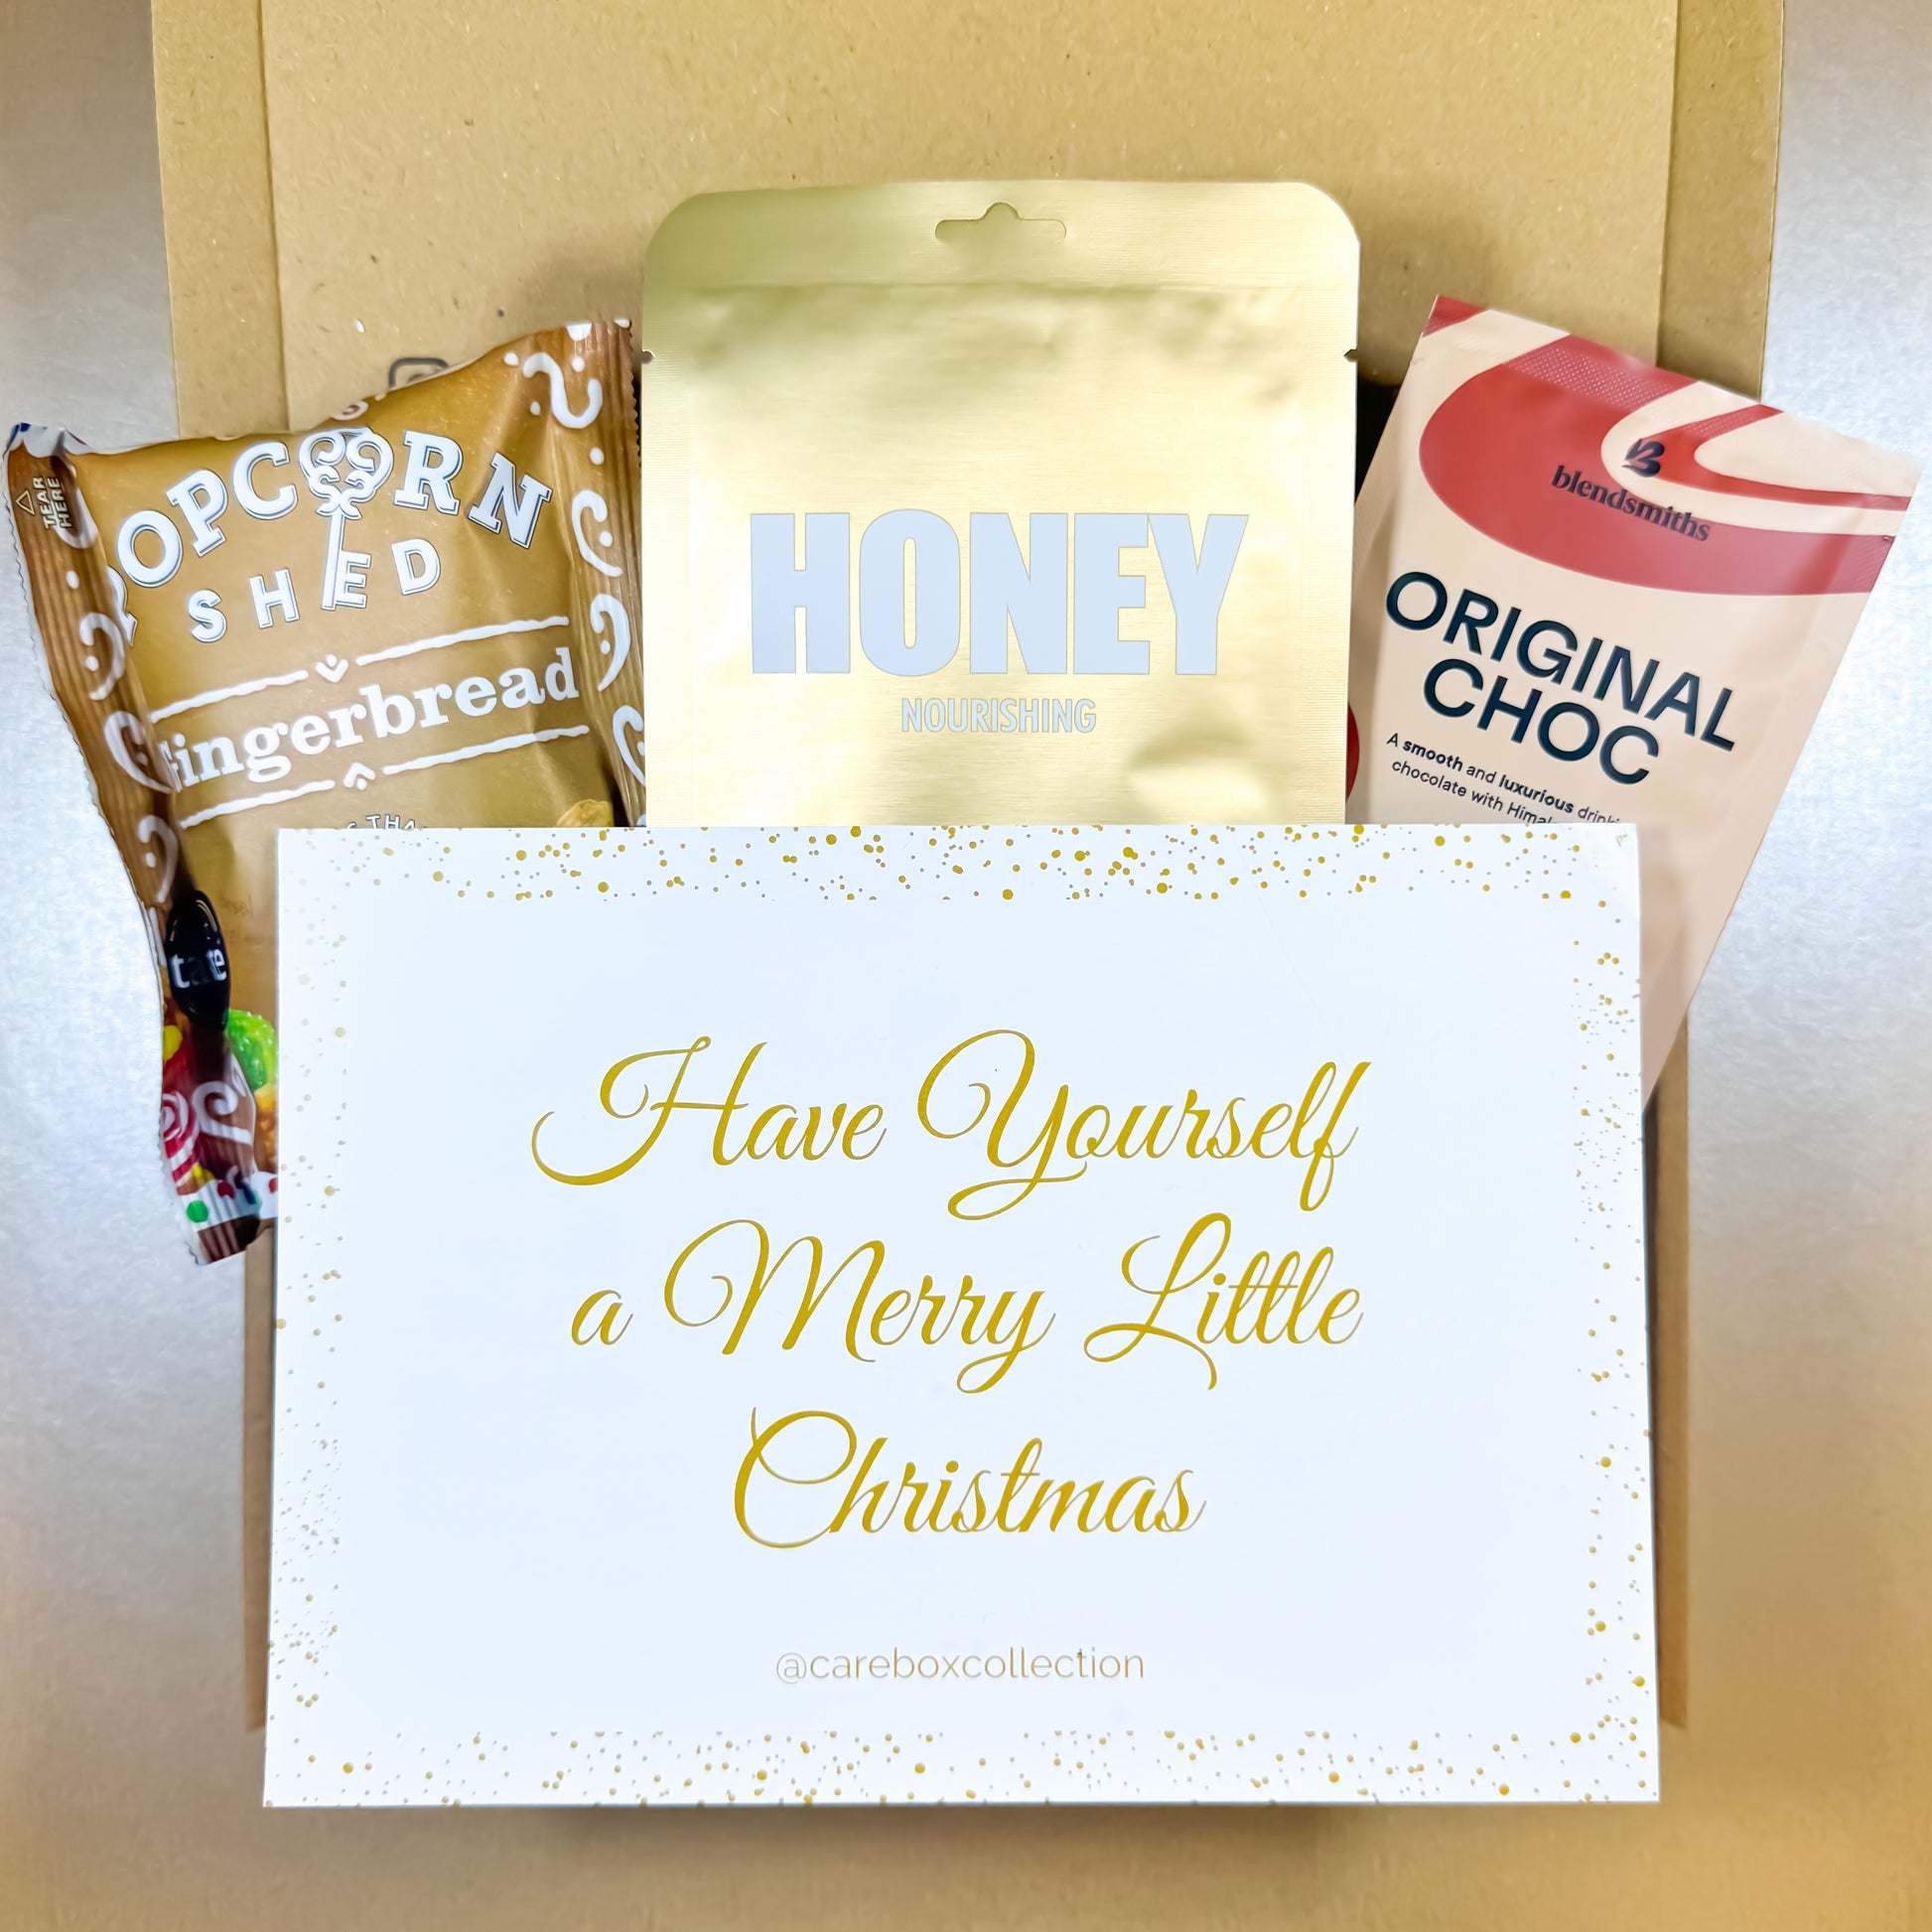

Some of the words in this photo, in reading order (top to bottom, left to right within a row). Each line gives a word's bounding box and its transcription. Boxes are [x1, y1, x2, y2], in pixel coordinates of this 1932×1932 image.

[33, 478, 57, 529] TEAR
[48, 478, 72, 528] HERE
[1552, 465, 1711, 542] blendsmiths
[187, 538, 441, 643] SHED
[750, 508, 1250, 677] HONEY
[1385, 571, 1735, 752] ORIGINAL
[900, 698, 1097, 734] NOURISHING
[1423, 658, 1659, 785] CHOC
[1386, 733, 1399, 748] A
[1402, 740, 1463, 771] smooth
[1465, 763, 1497, 784] and
[1498, 774, 1575, 814] luxurious
[1391, 759, 1466, 797] chocolate
[1471, 790, 1503, 812] with
[531, 1035, 888, 1186] Have
[916, 1029, 1371, 1221] Yourself
[571, 1289, 633, 1346] a
[663, 1219, 1057, 1395] Merry
[1083, 1212, 1364, 1391] Little
[734, 1407, 1206, 1550] Christmas
[775, 1646, 1145, 1685] @careboxcollection
